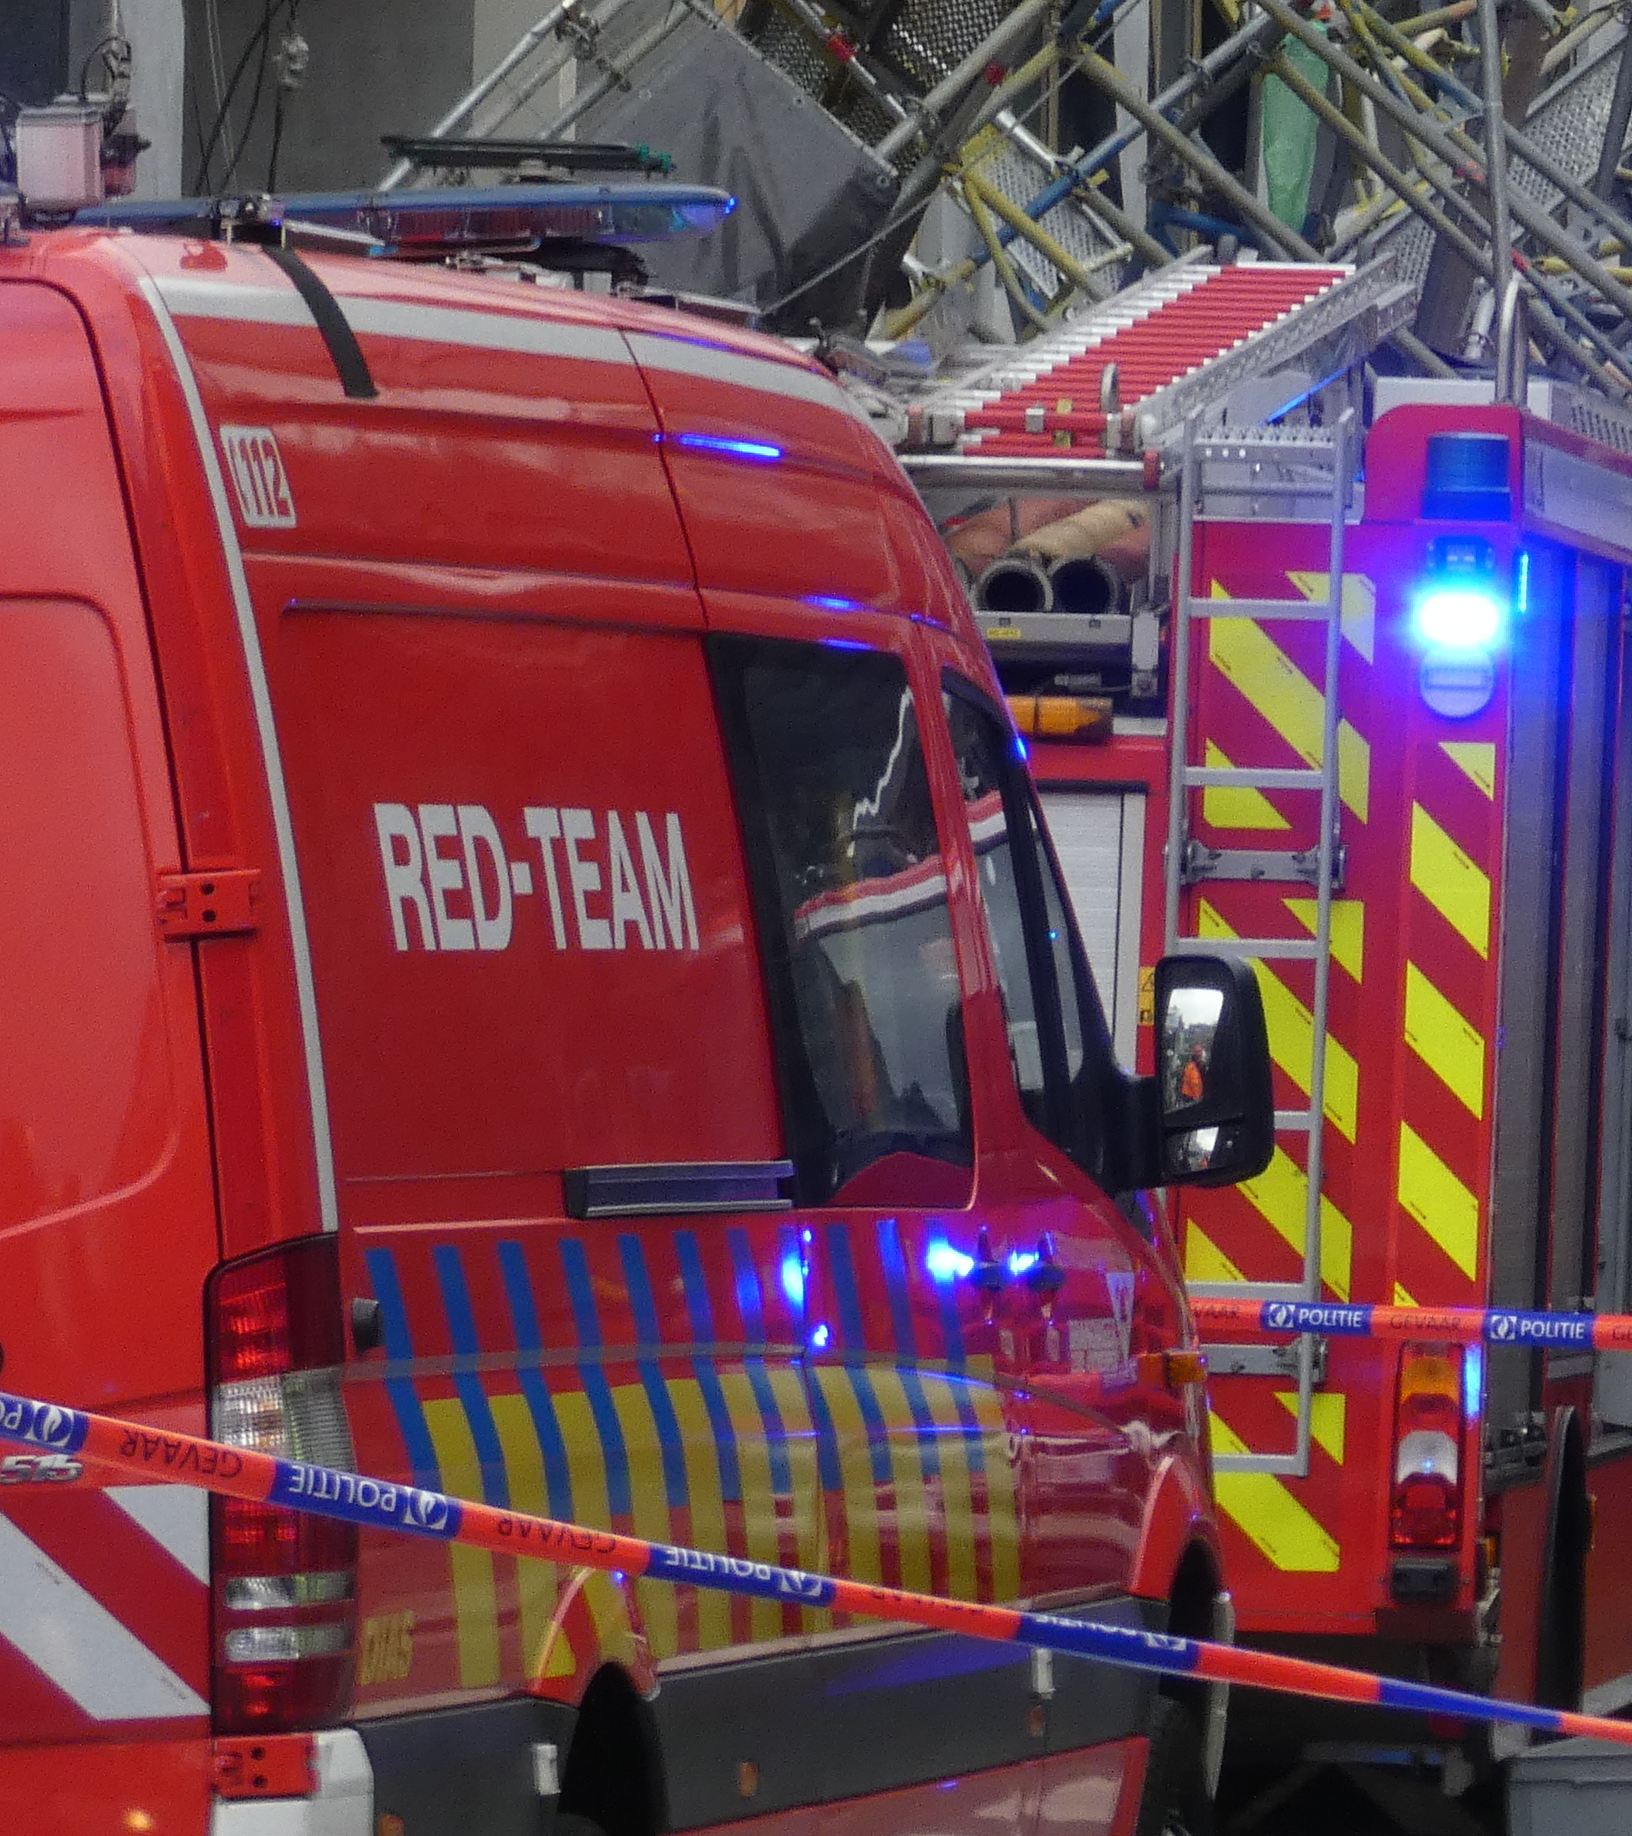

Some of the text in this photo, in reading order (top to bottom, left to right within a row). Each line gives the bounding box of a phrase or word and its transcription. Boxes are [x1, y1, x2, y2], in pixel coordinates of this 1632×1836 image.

[239, 437, 291, 518] 112
[373, 802, 699, 951] RED-TEAM
[1299, 1308, 1363, 1329] POLITIE
[1389, 1315, 1461, 1332] GEVAAR
[1519, 1319, 1585, 1340] POLITIE
[119, 1428, 243, 1479] GEVAAR
[288, 1464, 397, 1513] POLITIE
